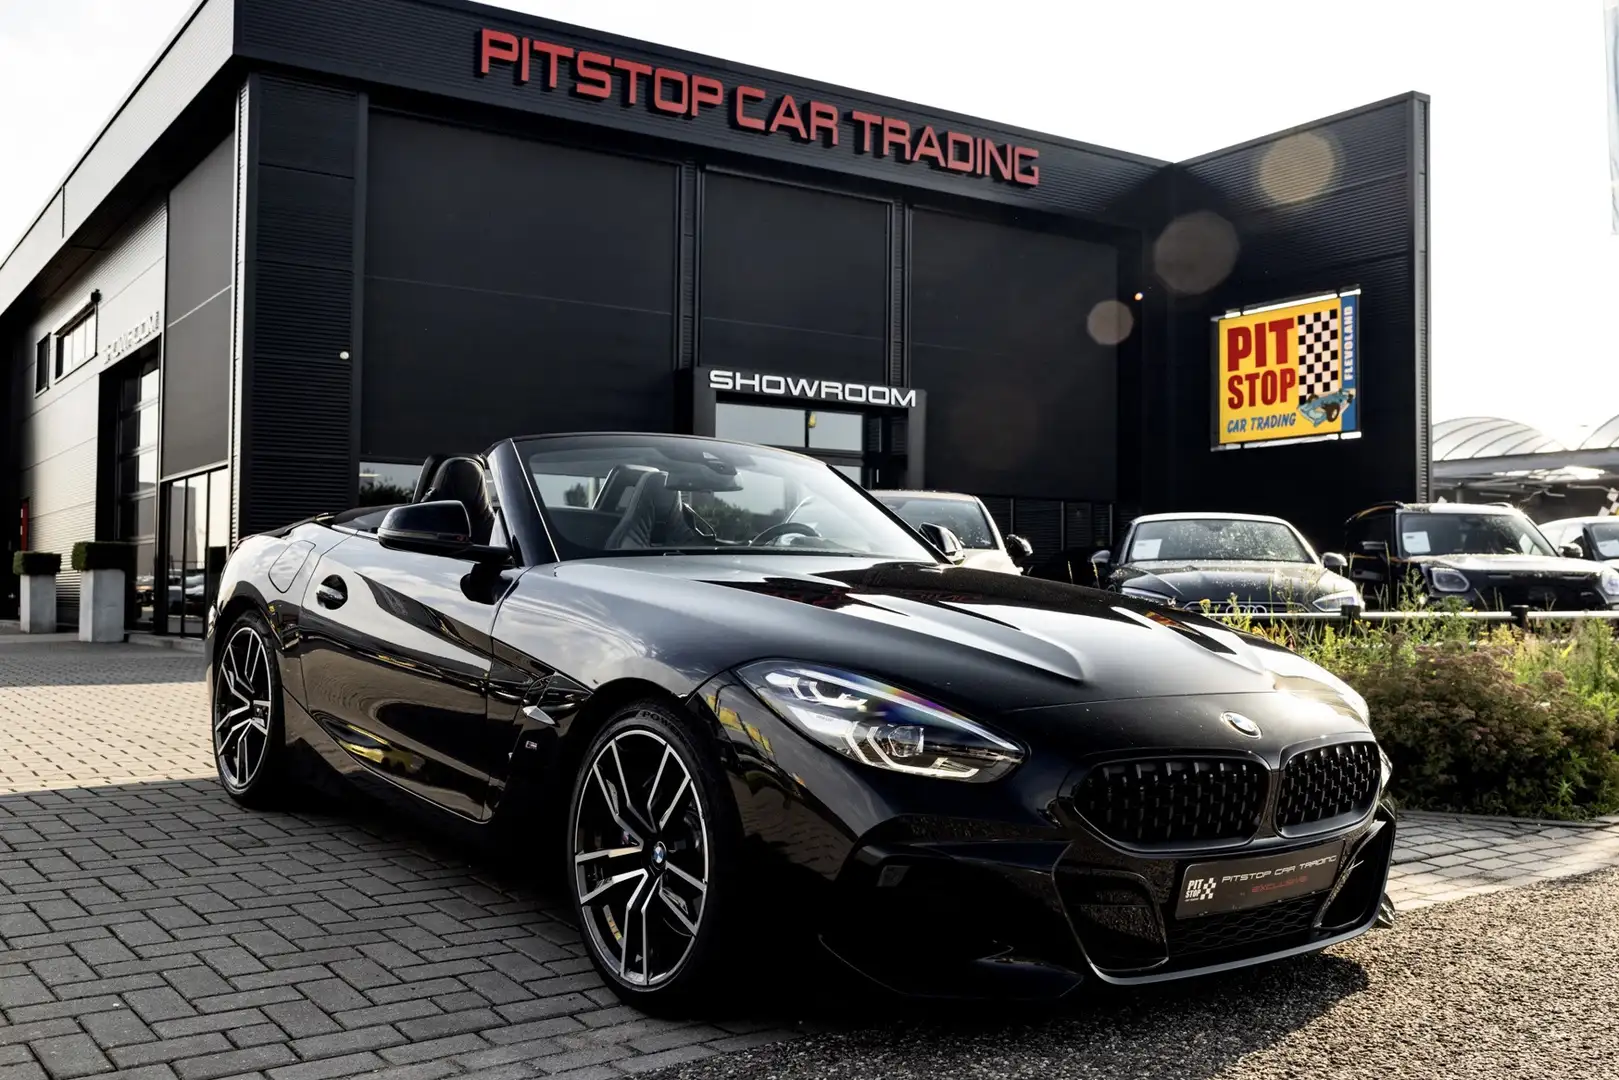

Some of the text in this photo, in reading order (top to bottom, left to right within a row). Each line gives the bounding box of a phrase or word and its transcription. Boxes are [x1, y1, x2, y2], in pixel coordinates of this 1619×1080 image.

[481, 28, 1039, 186] PITSTOP CAR TRADING
[1227, 317, 1295, 372] PIT
[1343, 306, 1354, 381] FLEVOLAND
[709, 369, 917, 407] SHOWROOM
[1227, 368, 1296, 410] STOP
[1227, 412, 1297, 433] CAR TRADING
[1185, 889, 1201, 898] STOP
[1187, 879, 1203, 891] PIT
[1222, 870, 1272, 883] PITSTOP
[1274, 866, 1296, 876] CAR
